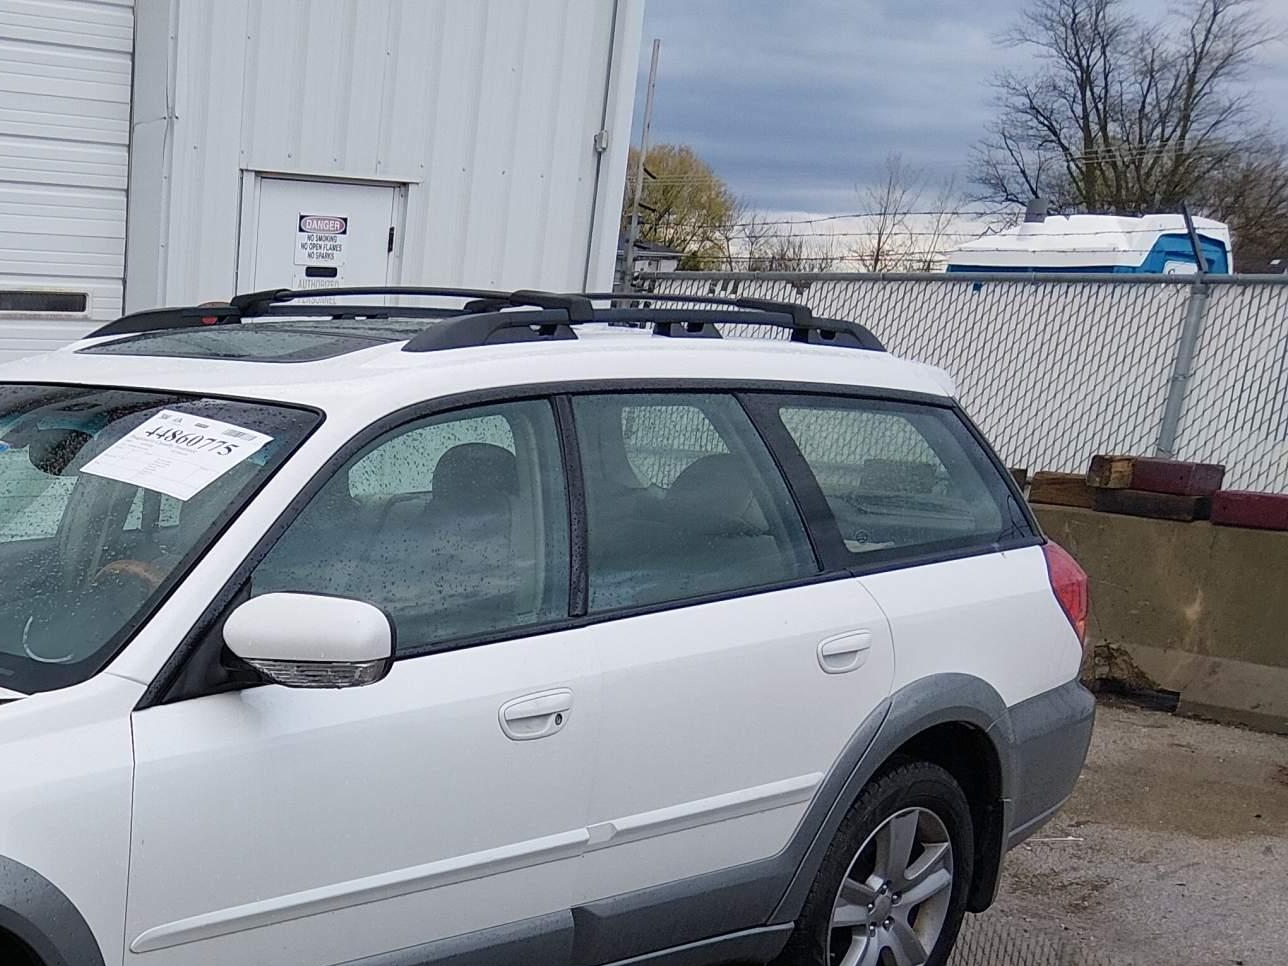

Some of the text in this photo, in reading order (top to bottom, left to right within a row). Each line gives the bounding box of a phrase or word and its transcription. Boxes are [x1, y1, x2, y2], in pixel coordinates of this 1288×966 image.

[306, 219, 340, 231] DANGER
[307, 234, 338, 243] NO SMOKING
[301, 242, 342, 252] NO OPEN FLAMES
[307, 251, 334, 260] NO SPARKS
[145, 425, 240, 456] 44860775
